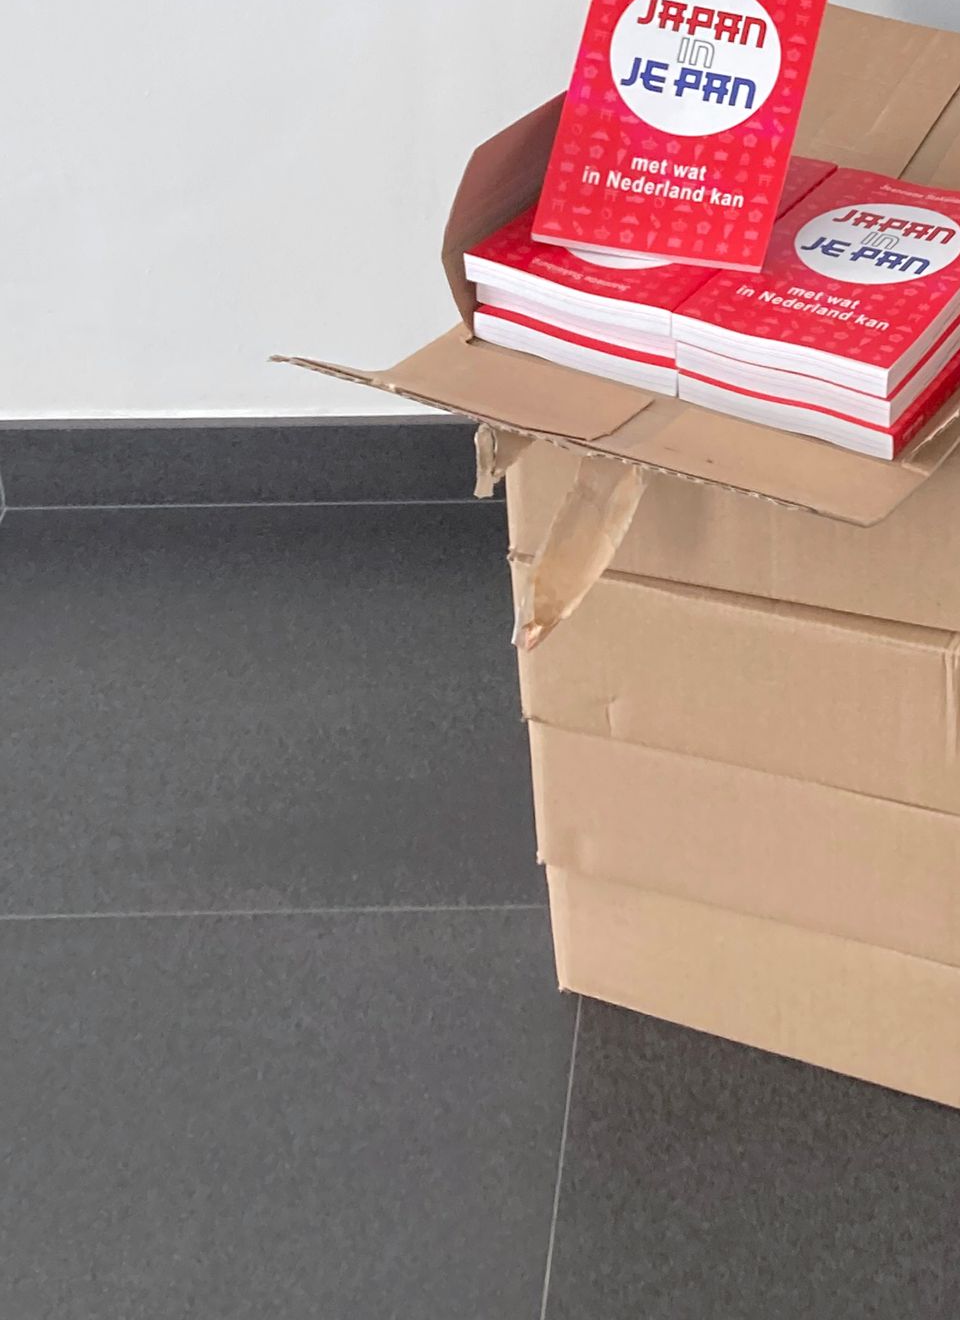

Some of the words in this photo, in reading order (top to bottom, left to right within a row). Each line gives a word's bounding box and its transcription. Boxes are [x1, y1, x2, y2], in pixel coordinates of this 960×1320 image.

[620, 57, 669, 93] JE
[674, 67, 757, 110] PAN
[582, 166, 600, 185] in
[606, 172, 705, 202] Nederland
[710, 186, 744, 208] kan
[631, 156, 667, 175] met
[673, 163, 707, 181] wat
[833, 209, 956, 245] JAPAN
[800, 236, 852, 258] JE
[849, 246, 931, 275] PAN
[736, 284, 756, 298] in
[758, 290, 854, 321] Nederland
[857, 310, 890, 331] kan
[787, 285, 825, 303] met
[827, 295, 860, 310] wat
